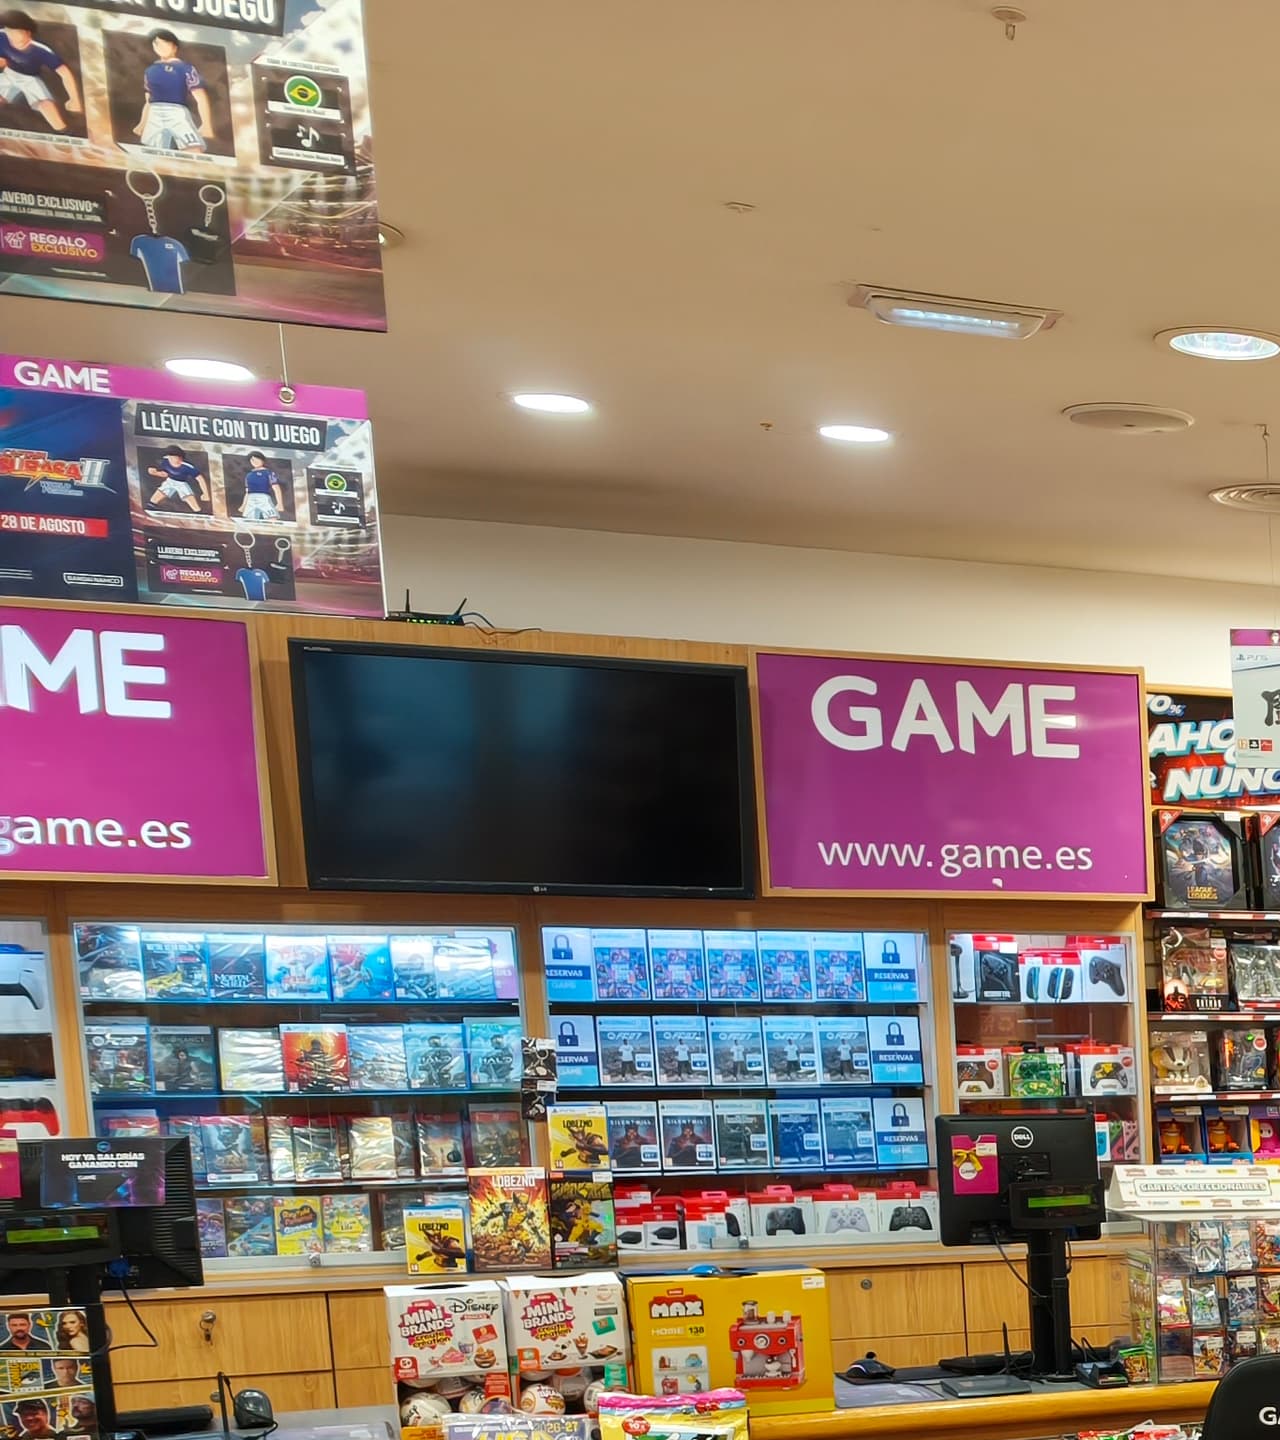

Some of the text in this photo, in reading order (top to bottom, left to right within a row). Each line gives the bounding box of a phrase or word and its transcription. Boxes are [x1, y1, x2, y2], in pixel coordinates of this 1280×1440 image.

[29, 232, 87, 248] REGALO
[31, 244, 98, 258] EXCLUSIVO
[14, 361, 110, 393] GAME
[141, 409, 320, 445] LLÉVATE CON TU JUEGO
[1, 513, 85, 534] 28 DE AGOSTO
[0, 624, 172, 719] ME
[811, 675, 1080, 759] GAME
[817, 841, 1093, 878] www.game.es
[878, 1053, 914, 1062] RESERVAS
[1012, 1132, 1031, 1142] DELL
[491, 1175, 536, 1188] LOBEZNO
[403, 1307, 442, 1325] MINI
[651, 1300, 704, 1318] MAX
[400, 1318, 453, 1337] BRANDS
